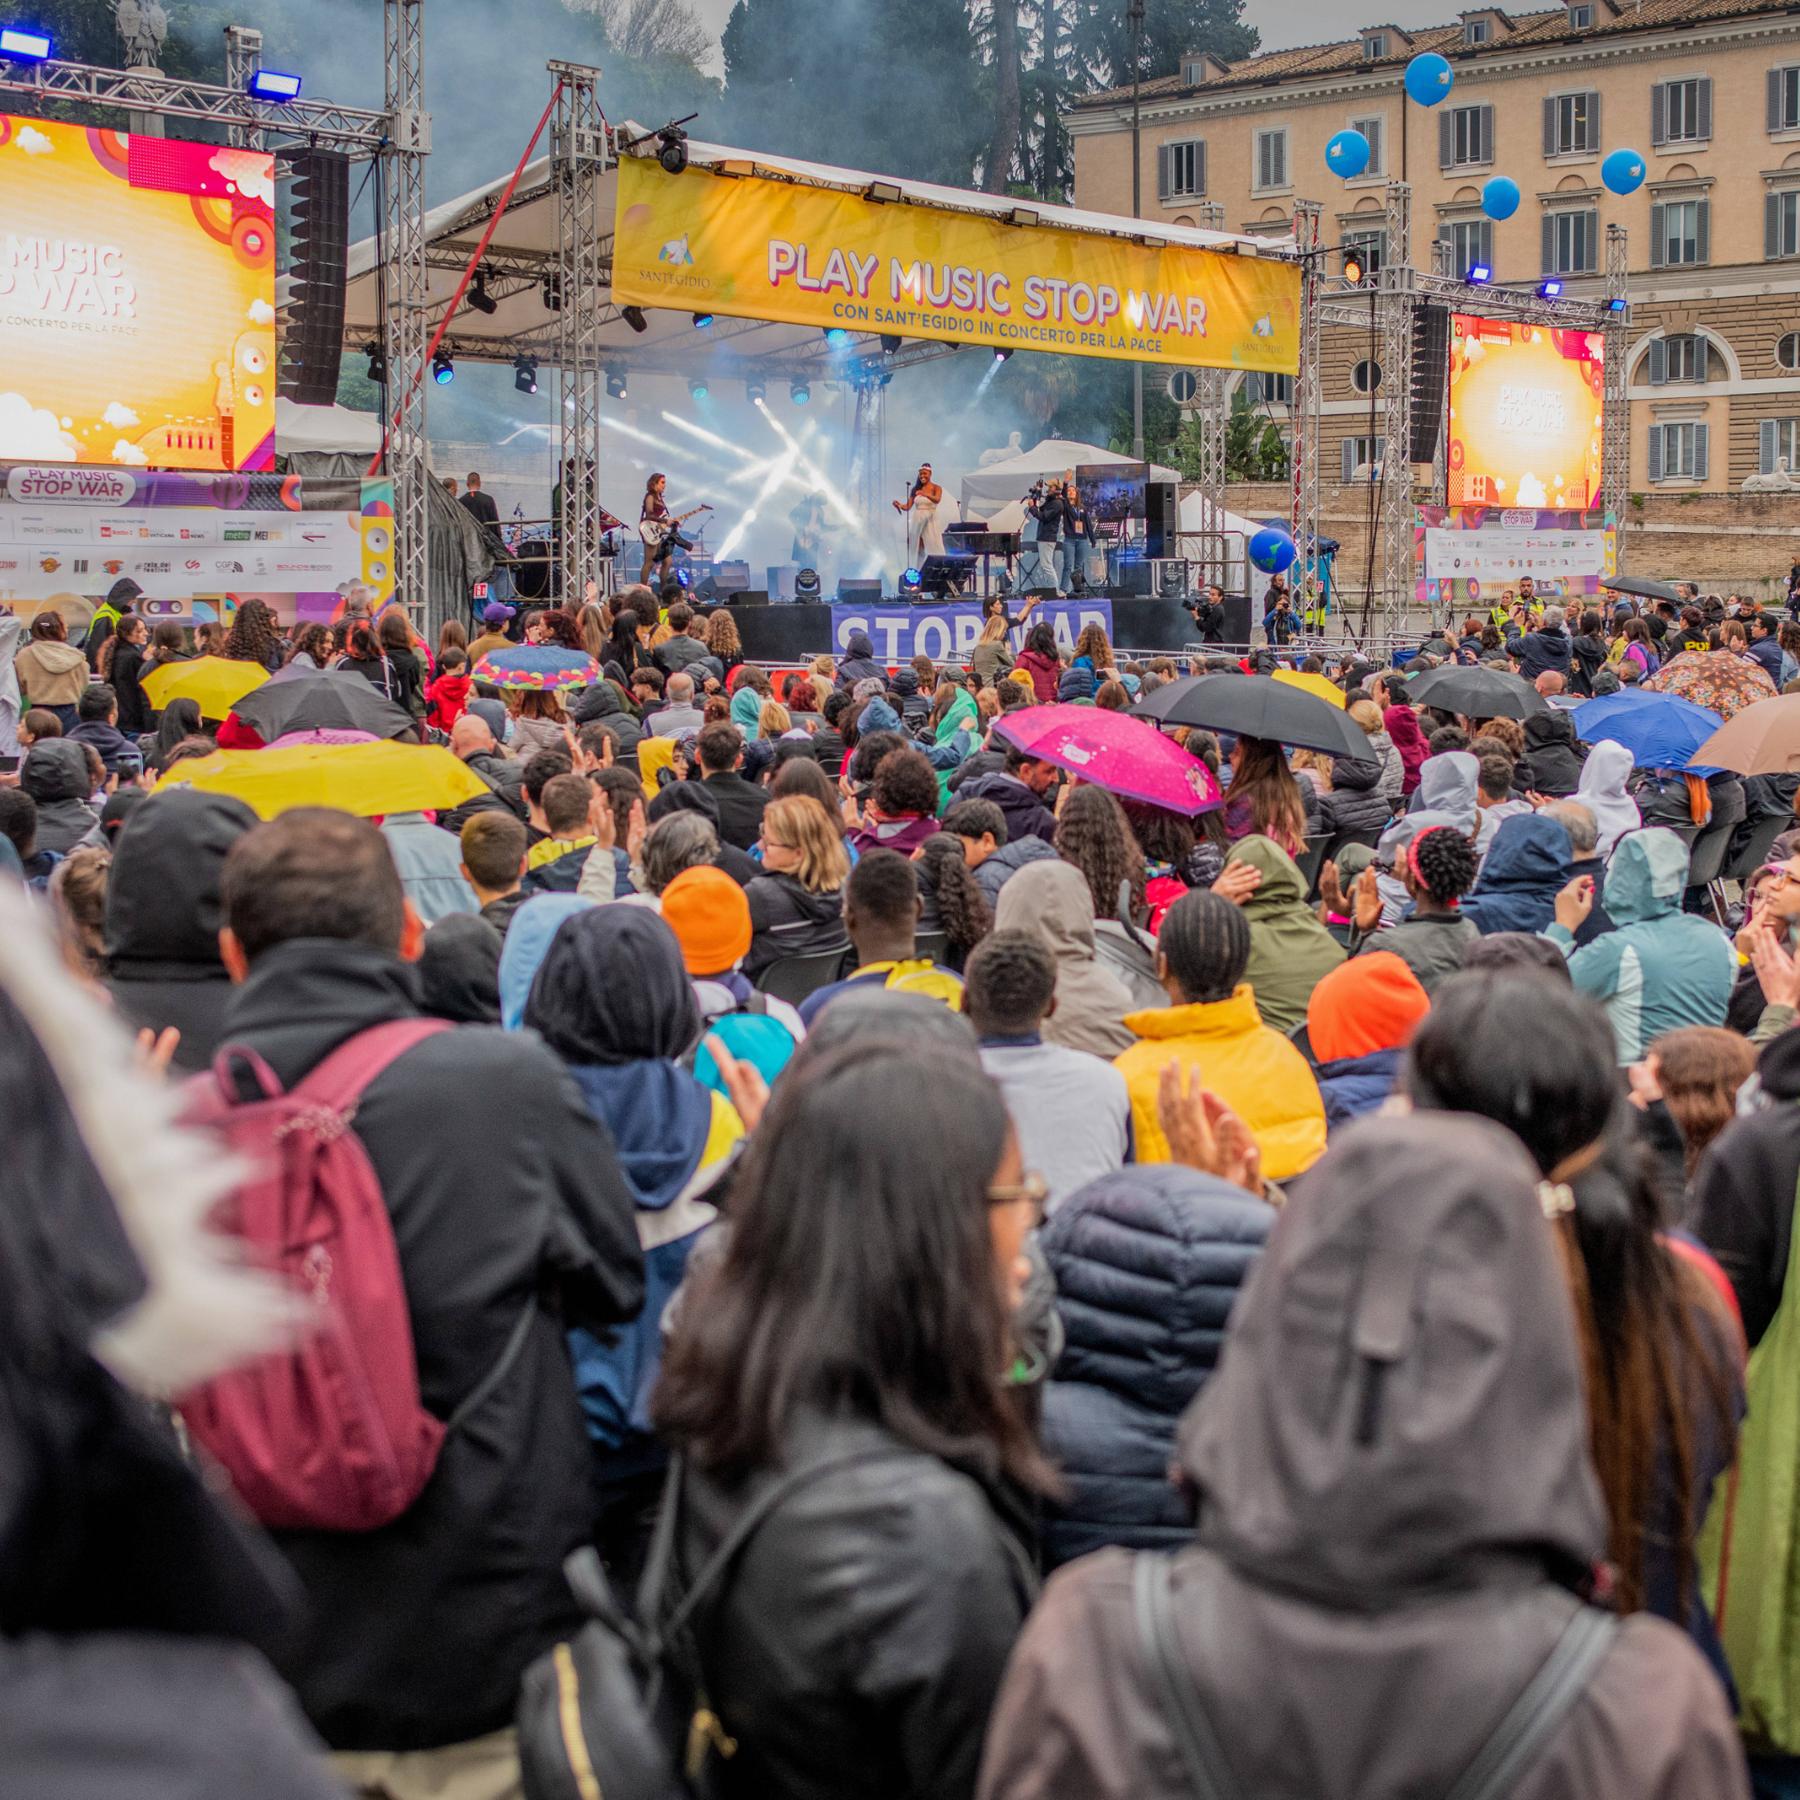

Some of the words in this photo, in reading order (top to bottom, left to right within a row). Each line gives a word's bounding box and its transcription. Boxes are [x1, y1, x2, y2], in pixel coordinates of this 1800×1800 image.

[5, 235, 125, 278] MUSIC
[29, 271, 137, 318] WAR
[767, 239, 880, 299] PLAY
[888, 256, 1011, 317] MUSIC
[1022, 275, 1120, 327] STOP
[1126, 287, 1208, 337] WAR
[6, 315, 69, 330] CONCERTO
[832, 303, 869, 321] CON
[875, 308, 975, 333] SANT'EGIDIO
[979, 321, 994, 335] IN
[999, 323, 1076, 345] CONCERTO
[1080, 332, 1106, 347] PER
[1109, 336, 1126, 350] LA
[1130, 338, 1163, 353] PACE
[20, 479, 74, 495] STOP
[78, 481, 125, 497] WAR
[28, 469, 66, 480] PLAY
[71, 471, 118, 482] MUSIC
[837, 615, 983, 665] STOP
